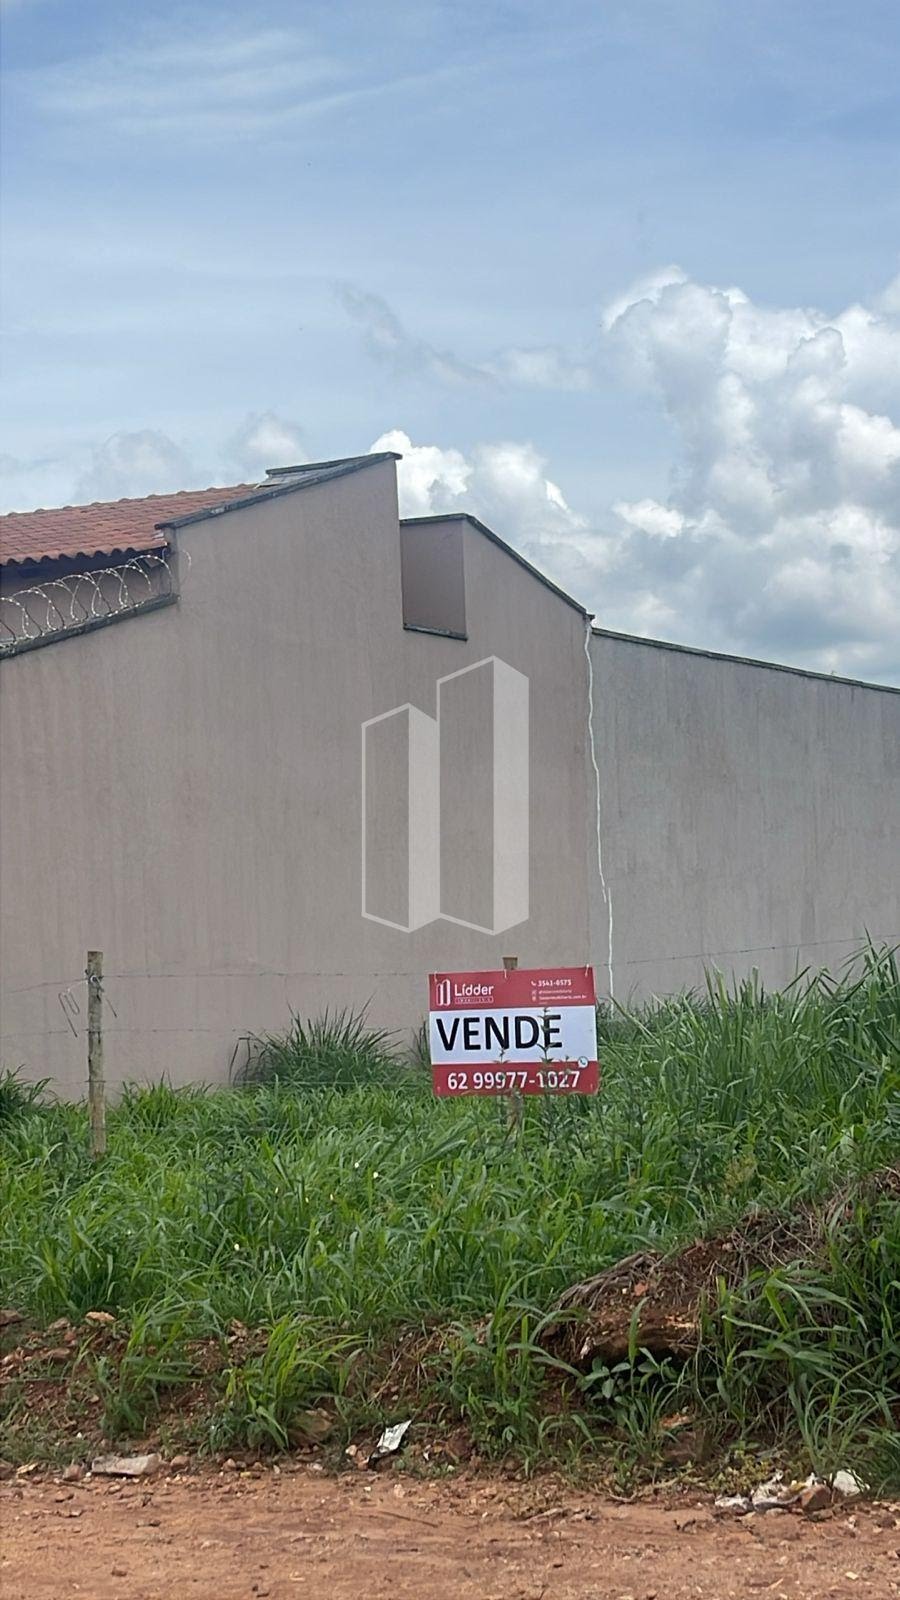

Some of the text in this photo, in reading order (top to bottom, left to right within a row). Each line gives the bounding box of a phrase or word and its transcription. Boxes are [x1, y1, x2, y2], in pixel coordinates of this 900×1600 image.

[436, 1015, 562, 1051] VENDE
[447, 1071, 580, 1089] 62 99977-1027
